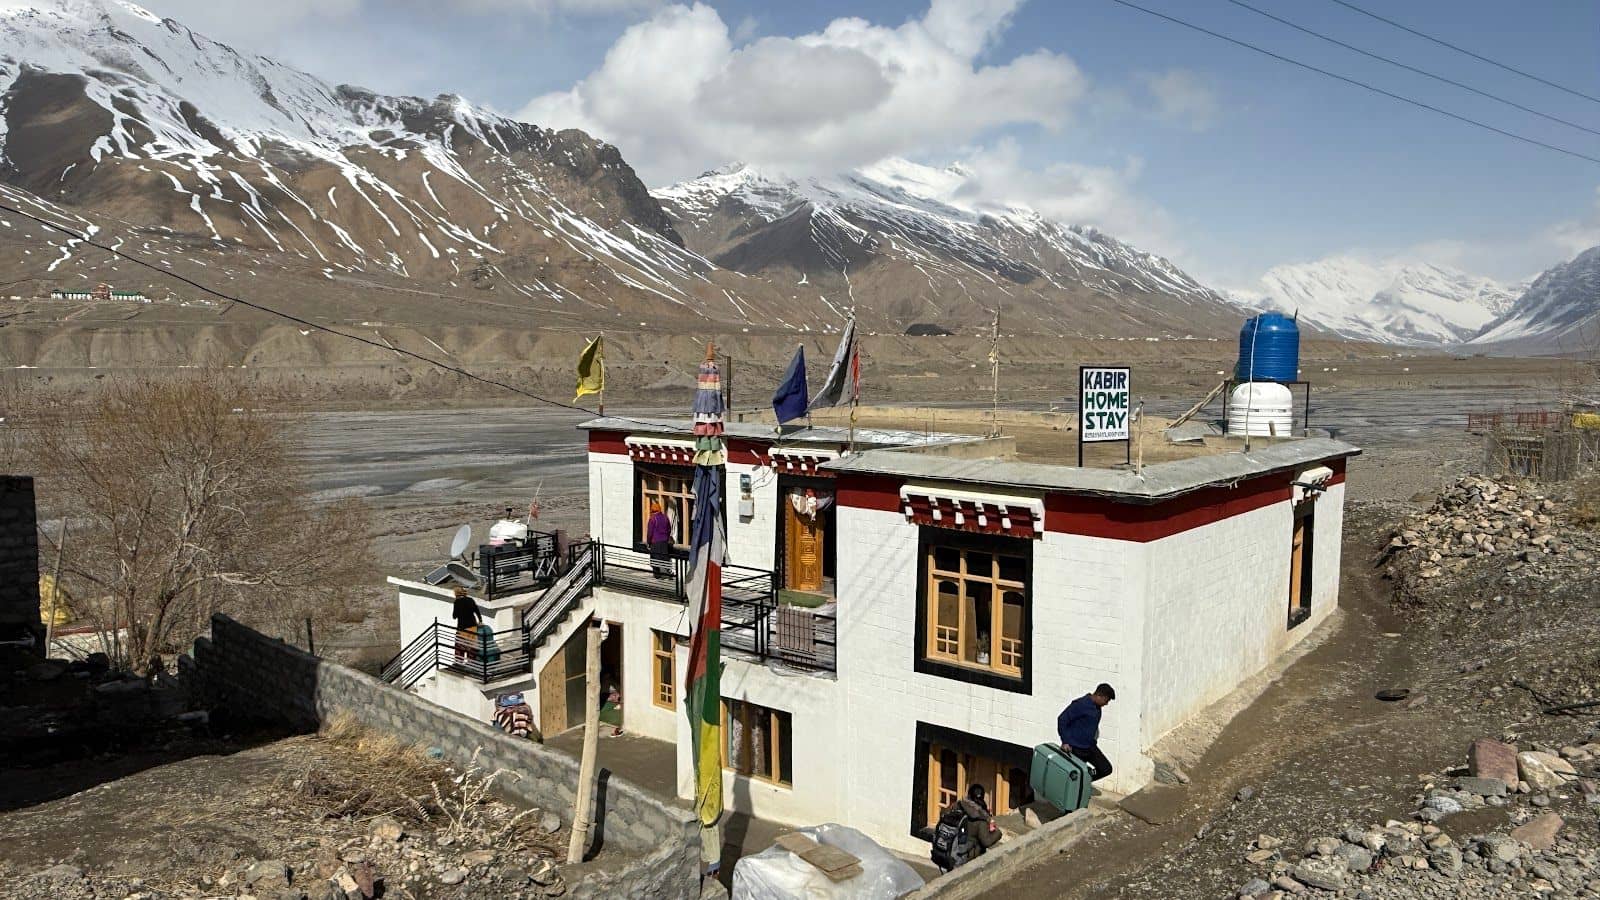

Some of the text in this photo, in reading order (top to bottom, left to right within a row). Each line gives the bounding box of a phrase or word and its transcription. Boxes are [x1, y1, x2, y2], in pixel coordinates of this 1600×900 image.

[1085, 371, 1126, 389] KABIR
[1085, 392, 1127, 409] HOME
[1086, 412, 1126, 429] STAY
